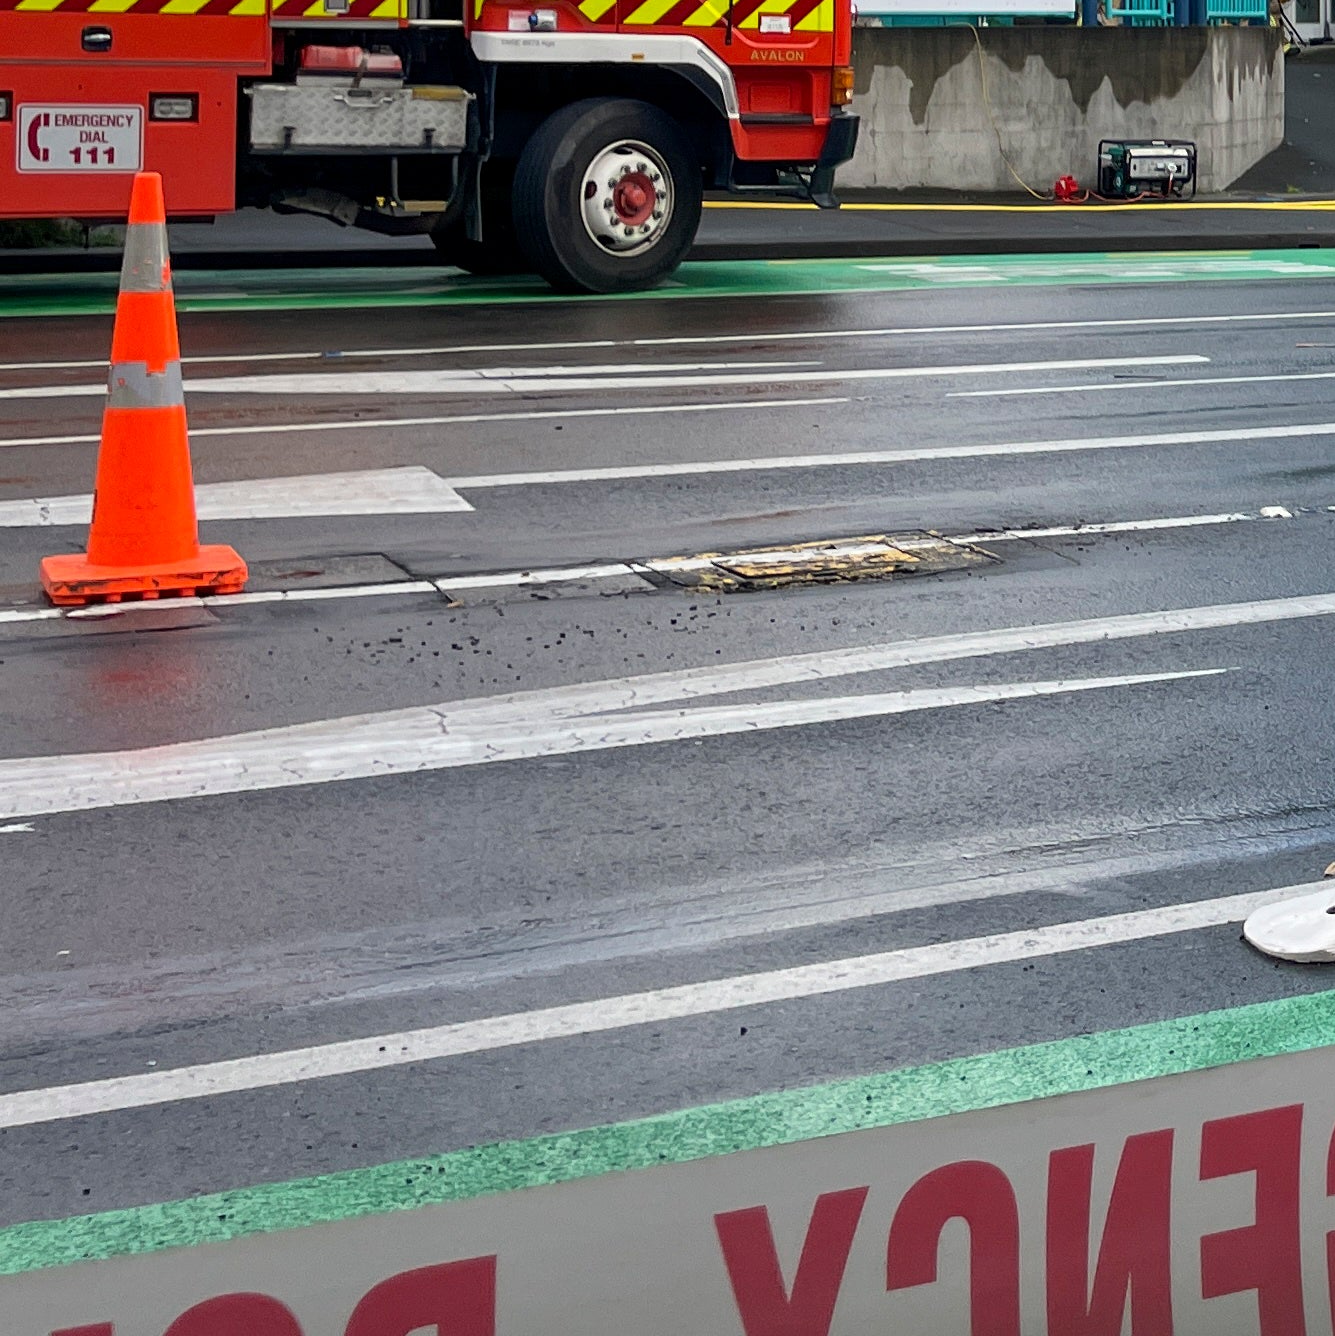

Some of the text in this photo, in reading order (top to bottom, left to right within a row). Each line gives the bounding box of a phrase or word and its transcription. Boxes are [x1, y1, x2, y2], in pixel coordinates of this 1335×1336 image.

[751, 50, 804, 62] AVALON
[55, 113, 133, 127] EMERGENCY
[80, 130, 108, 143] DIAL
[69, 146, 115, 164] 111
